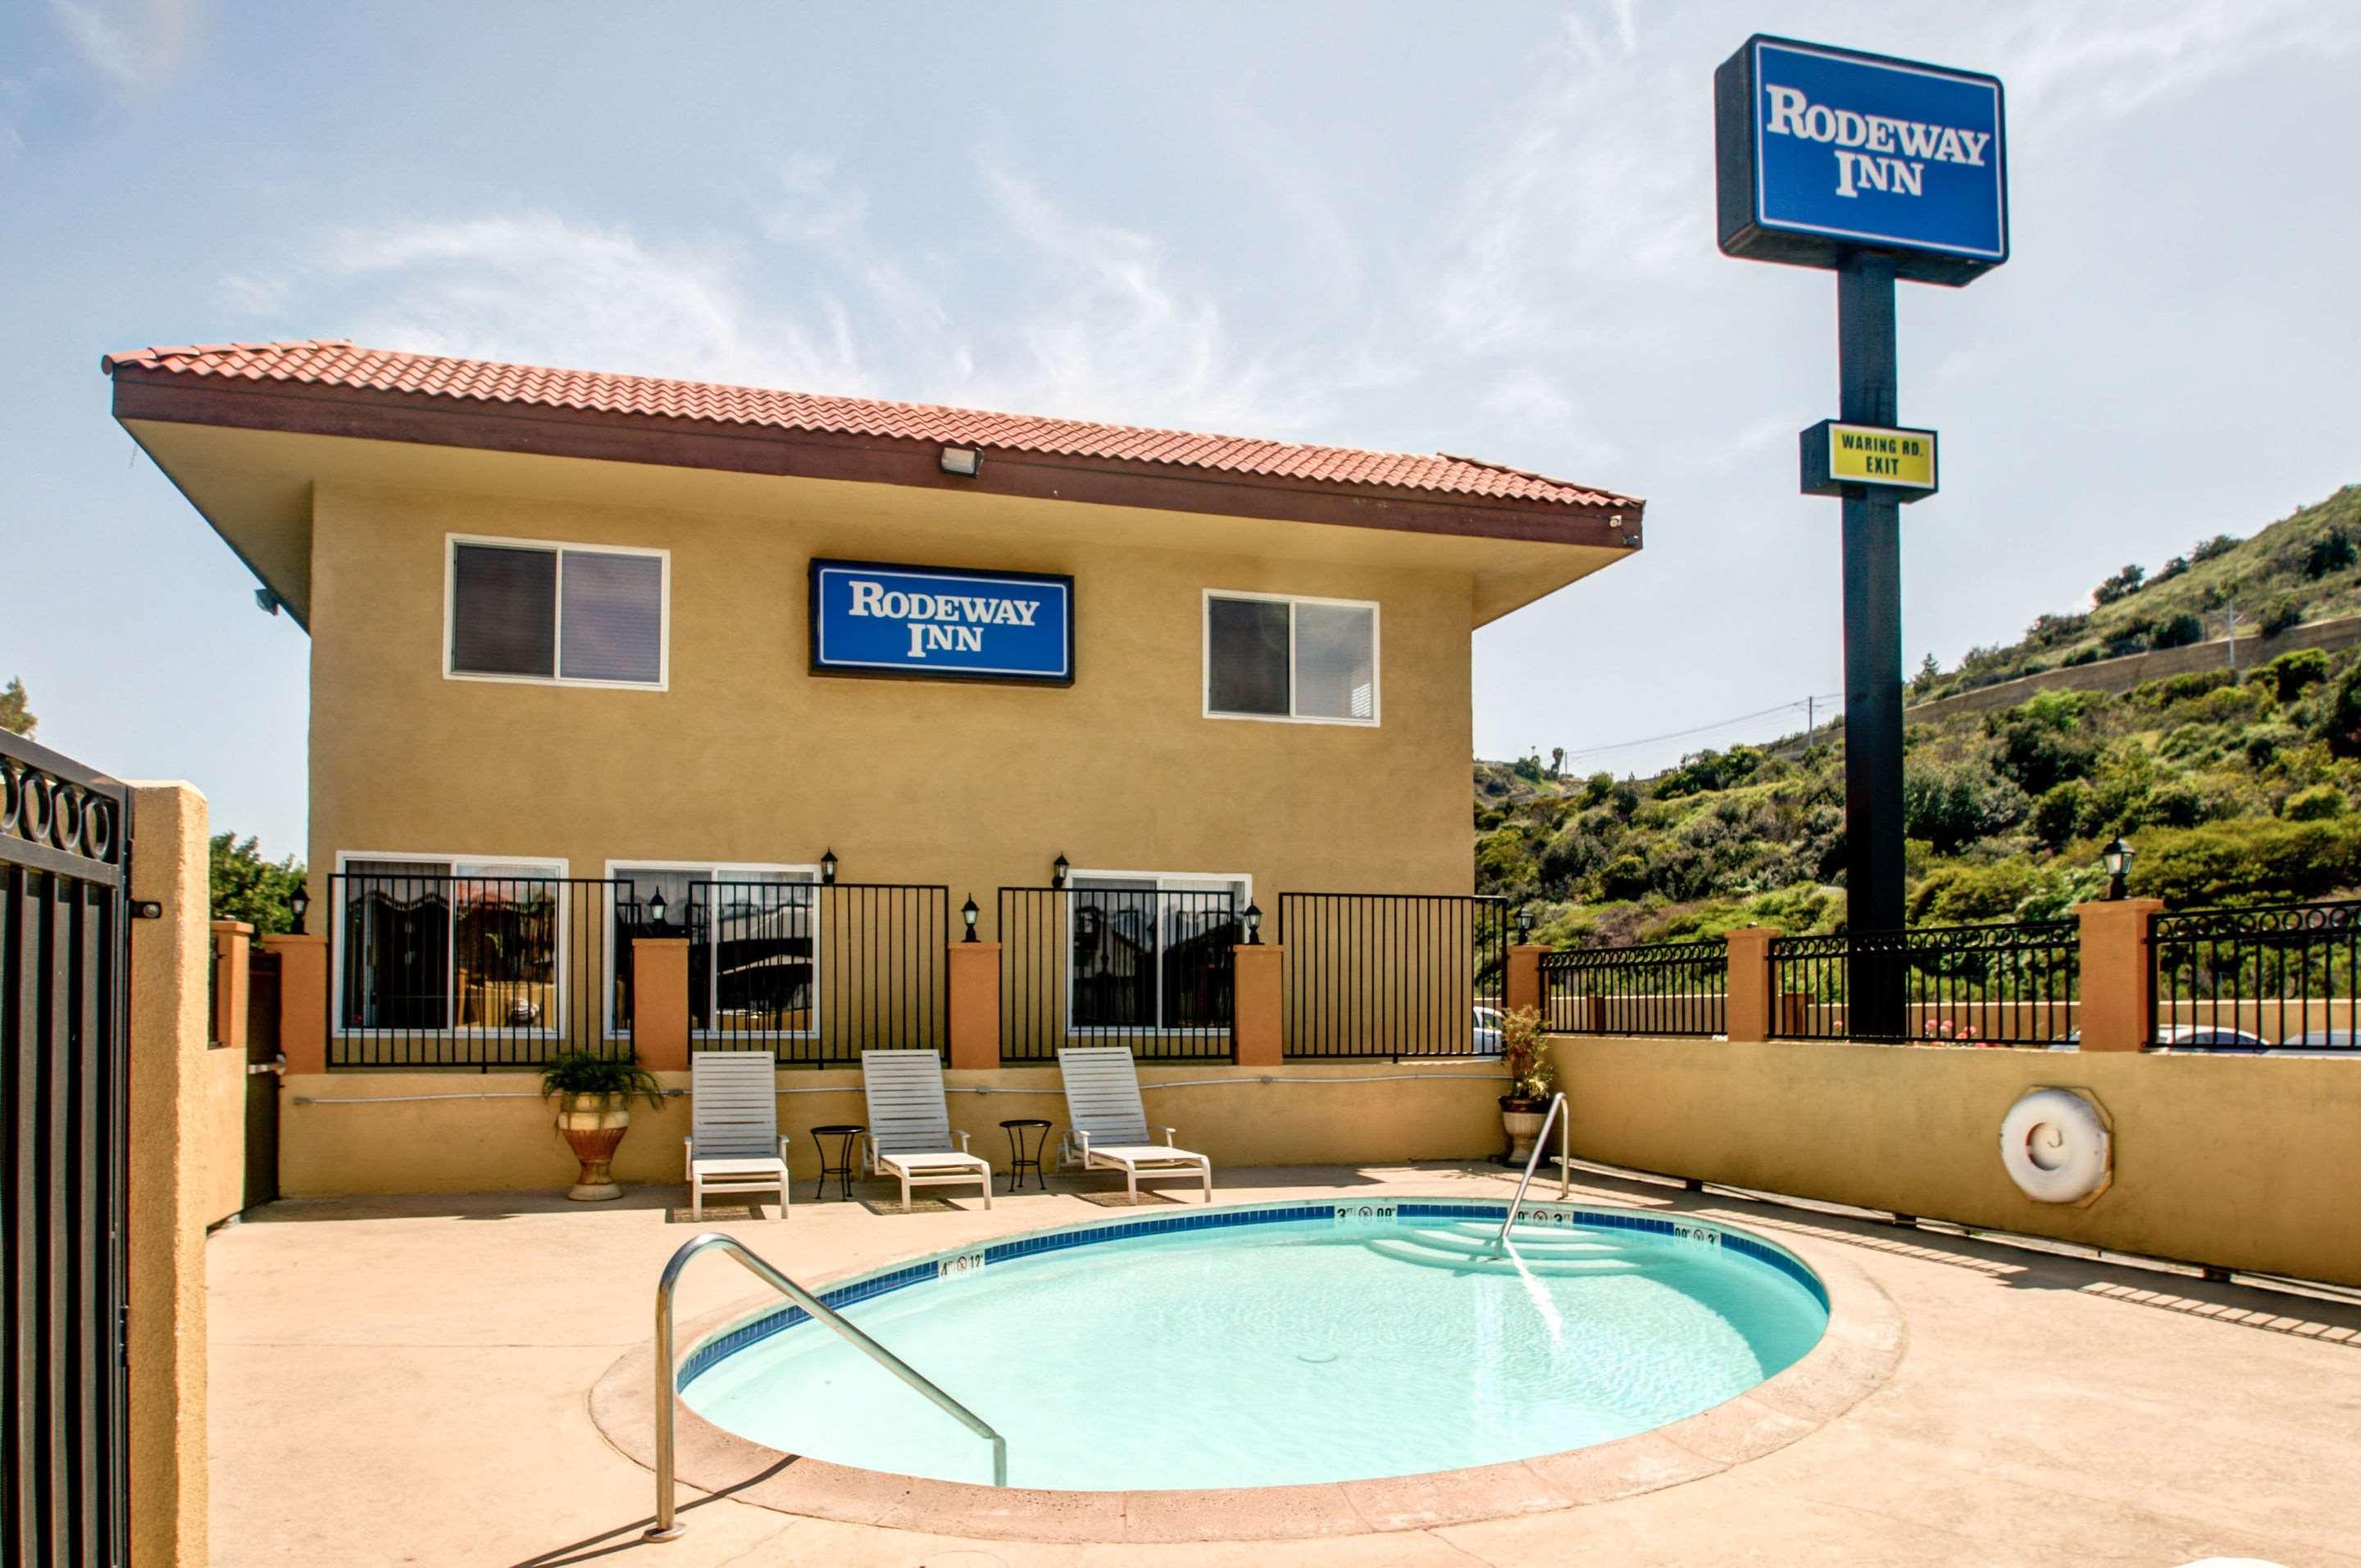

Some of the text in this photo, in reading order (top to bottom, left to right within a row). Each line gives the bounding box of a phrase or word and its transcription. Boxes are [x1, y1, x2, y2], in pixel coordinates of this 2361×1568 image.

[1766, 84, 1990, 166] RODEWAY
[1834, 150, 1924, 198] INN
[1842, 434, 1896, 453] WARING
[1866, 457, 1899, 475] EXIT
[848, 580, 1039, 625] RODEWAY
[907, 624, 984, 657] INN
